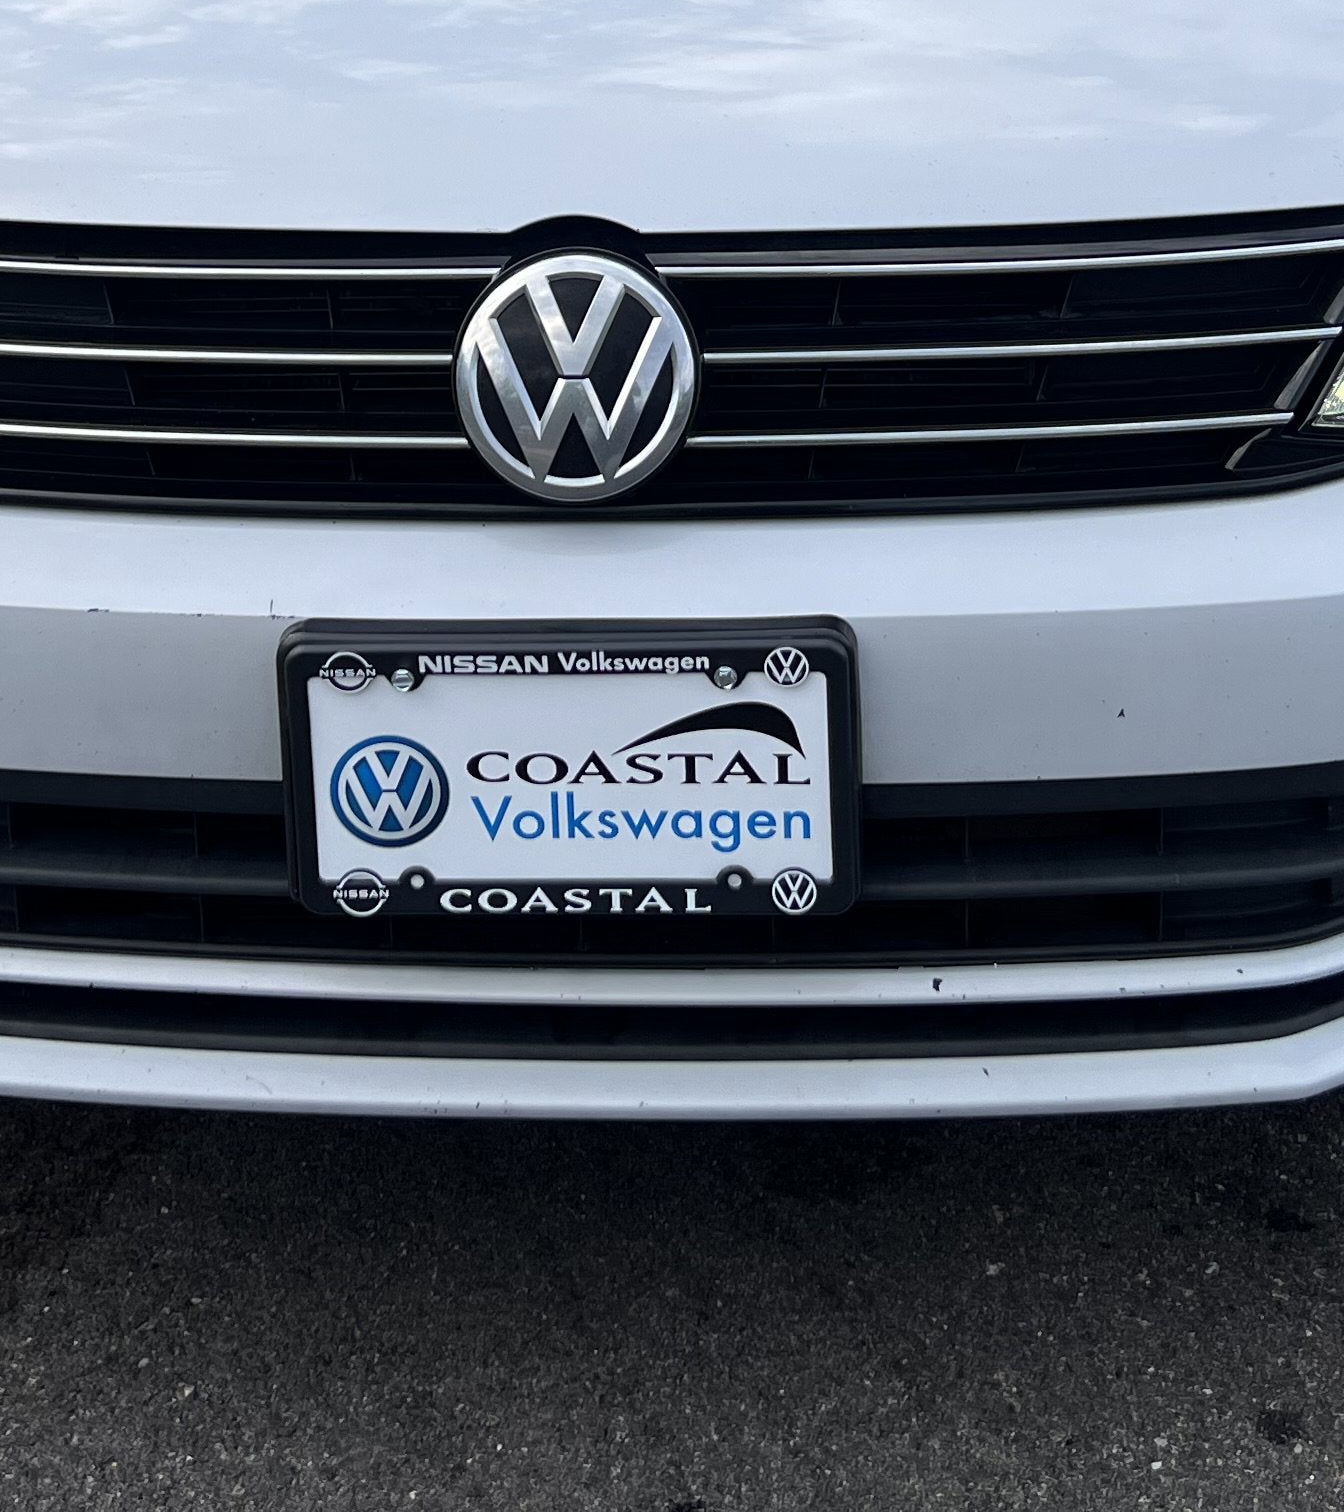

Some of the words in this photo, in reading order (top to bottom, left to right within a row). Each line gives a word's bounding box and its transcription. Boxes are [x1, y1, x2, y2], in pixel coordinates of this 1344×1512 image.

[319, 668, 376, 678] NISSAN
[419, 655, 548, 674] NISSAN
[558, 652, 710, 673] Volkswagen
[466, 750, 811, 785] COASTAL
[470, 791, 811, 852] Volkswagen
[333, 889, 390, 899] NISSAN
[439, 887, 712, 914] COASTAL
